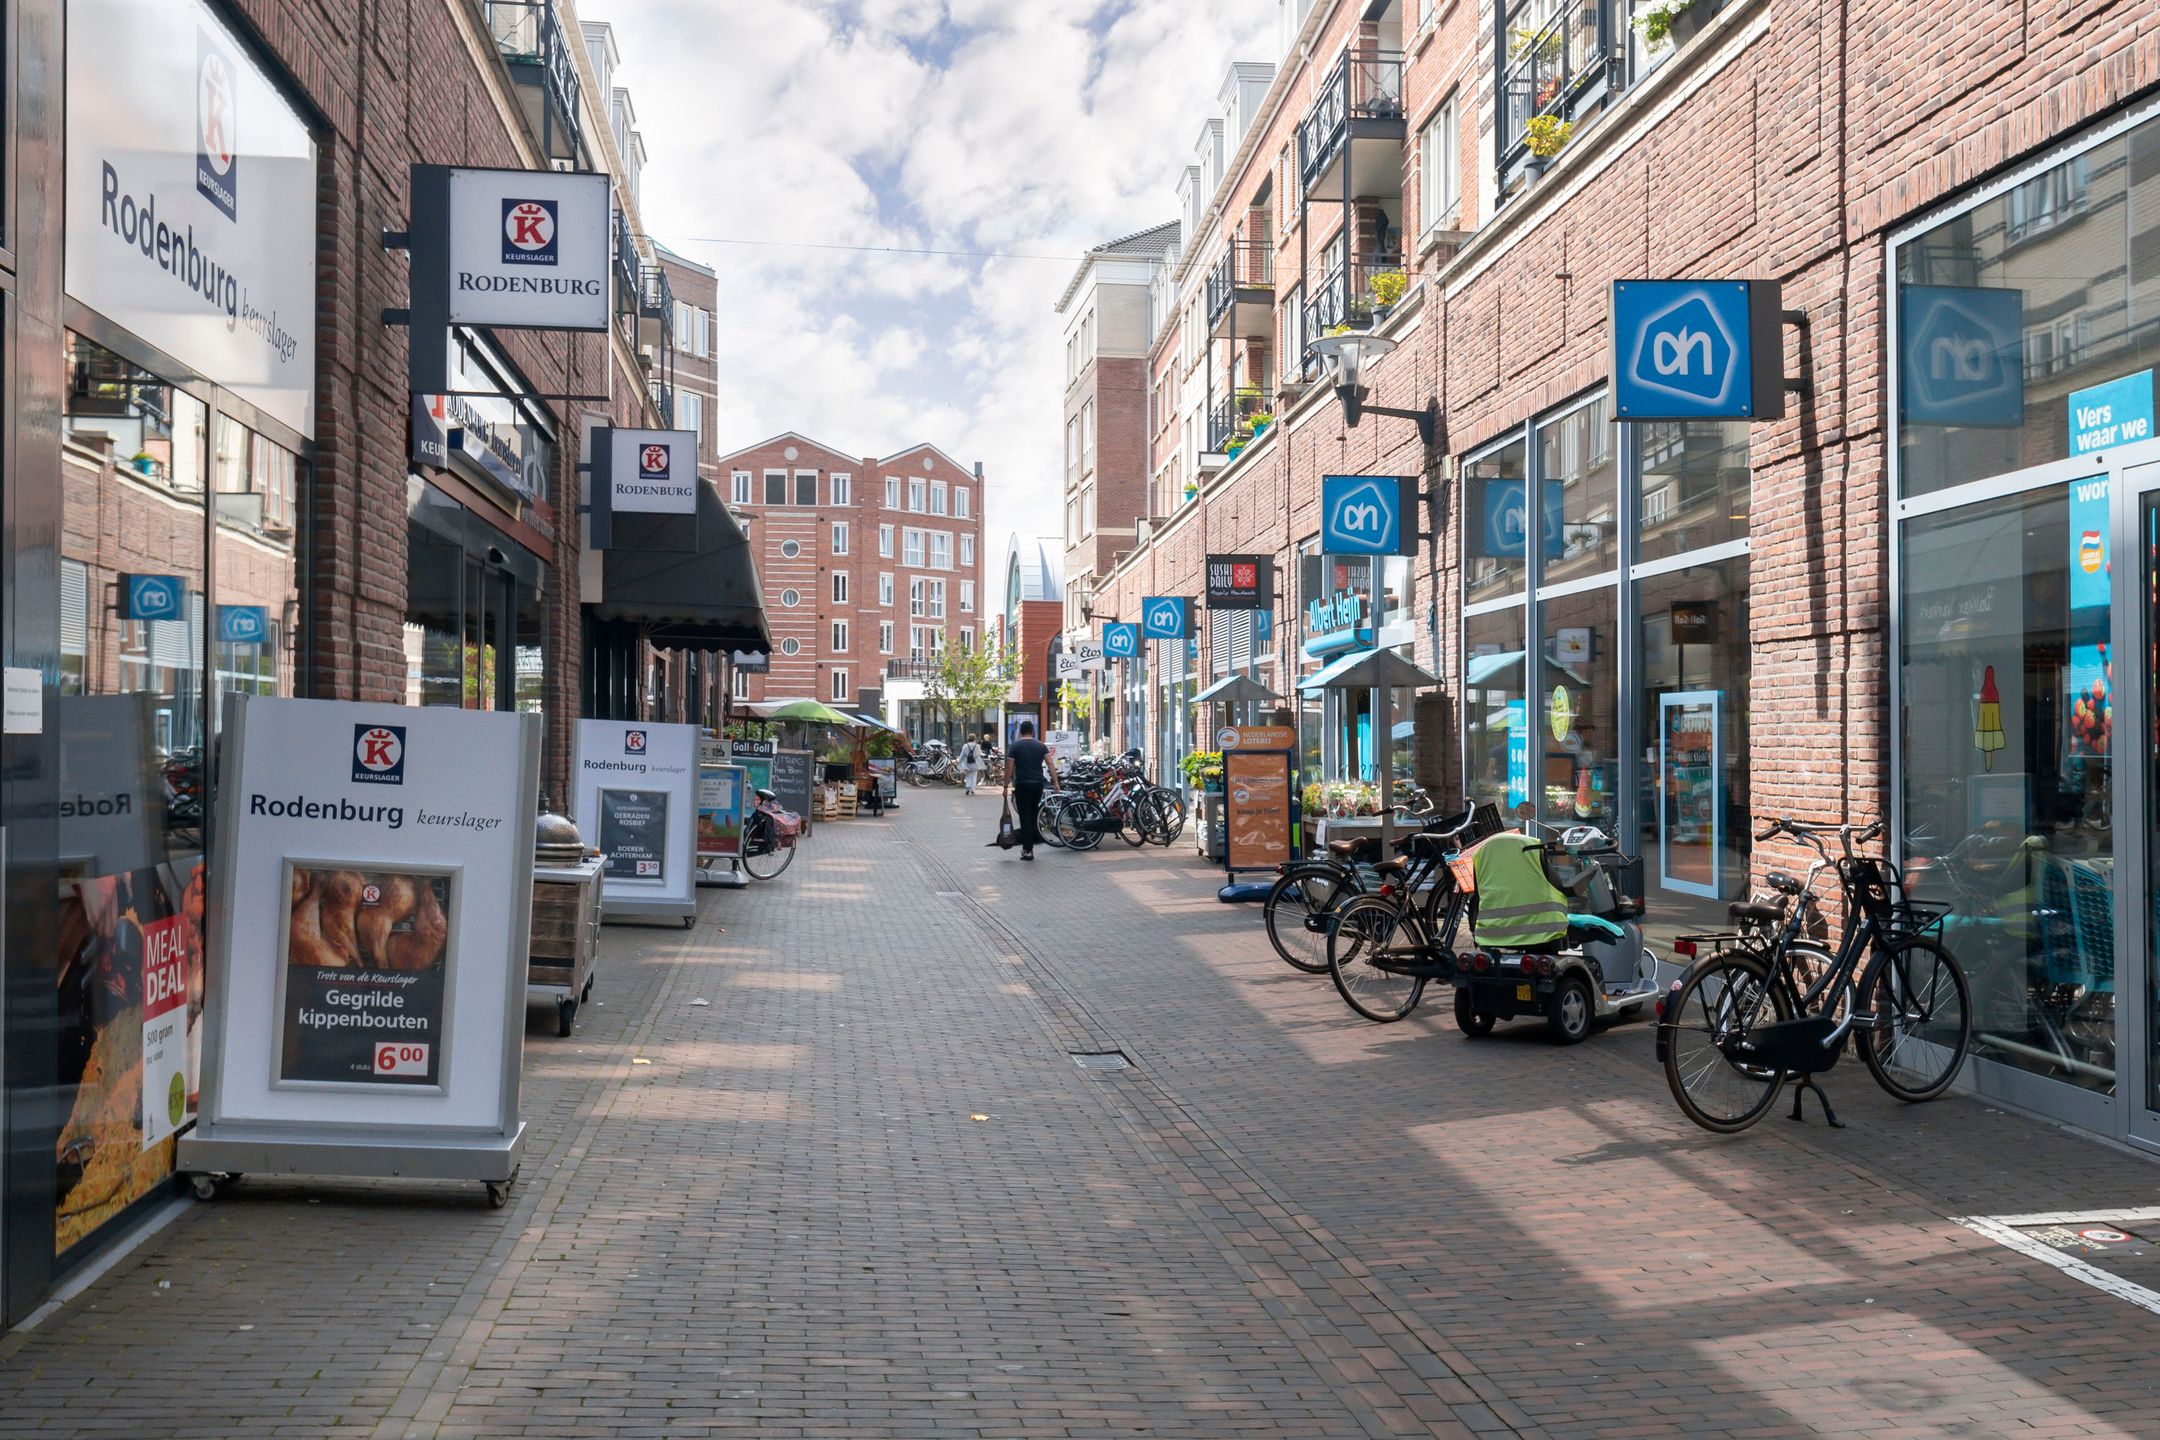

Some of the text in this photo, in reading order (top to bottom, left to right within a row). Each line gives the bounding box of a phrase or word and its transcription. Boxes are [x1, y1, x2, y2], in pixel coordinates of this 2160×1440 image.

[199, 167, 235, 211] KEURSLAGER
[102, 160, 297, 361] Rodenburg keurslager
[505, 253, 555, 262] KEURSLAGER
[458, 272, 600, 296] RODENBURG
[2077, 405, 2112, 430] Vers
[2077, 418, 2147, 451] waar we
[616, 484, 692, 497] RODENBURG
[1210, 564, 1232, 575] SUSHI
[1210, 576, 1232, 587] DAILY
[1309, 587, 1360, 632] Albert Heijn
[1080, 646, 1101, 659] Etos
[1060, 658, 1075, 669] Eto
[733, 742, 749, 751] Gall
[753, 743, 769, 752] Gall
[584, 760, 646, 773] Rodenburg
[355, 773, 400, 782] KEURSLAGER
[250, 794, 502, 831] Rodenburg keurslager
[614, 812, 650, 820] GEBRADEN
[147, 926, 185, 968] MEAL
[147, 967, 185, 1007] DEAL
[316, 971, 418, 988] Trots van de Keurslager
[326, 990, 404, 1010] Gegrilde
[298, 1009, 429, 1030] kippenbouten
[147, 1023, 174, 1047] 500 gram
